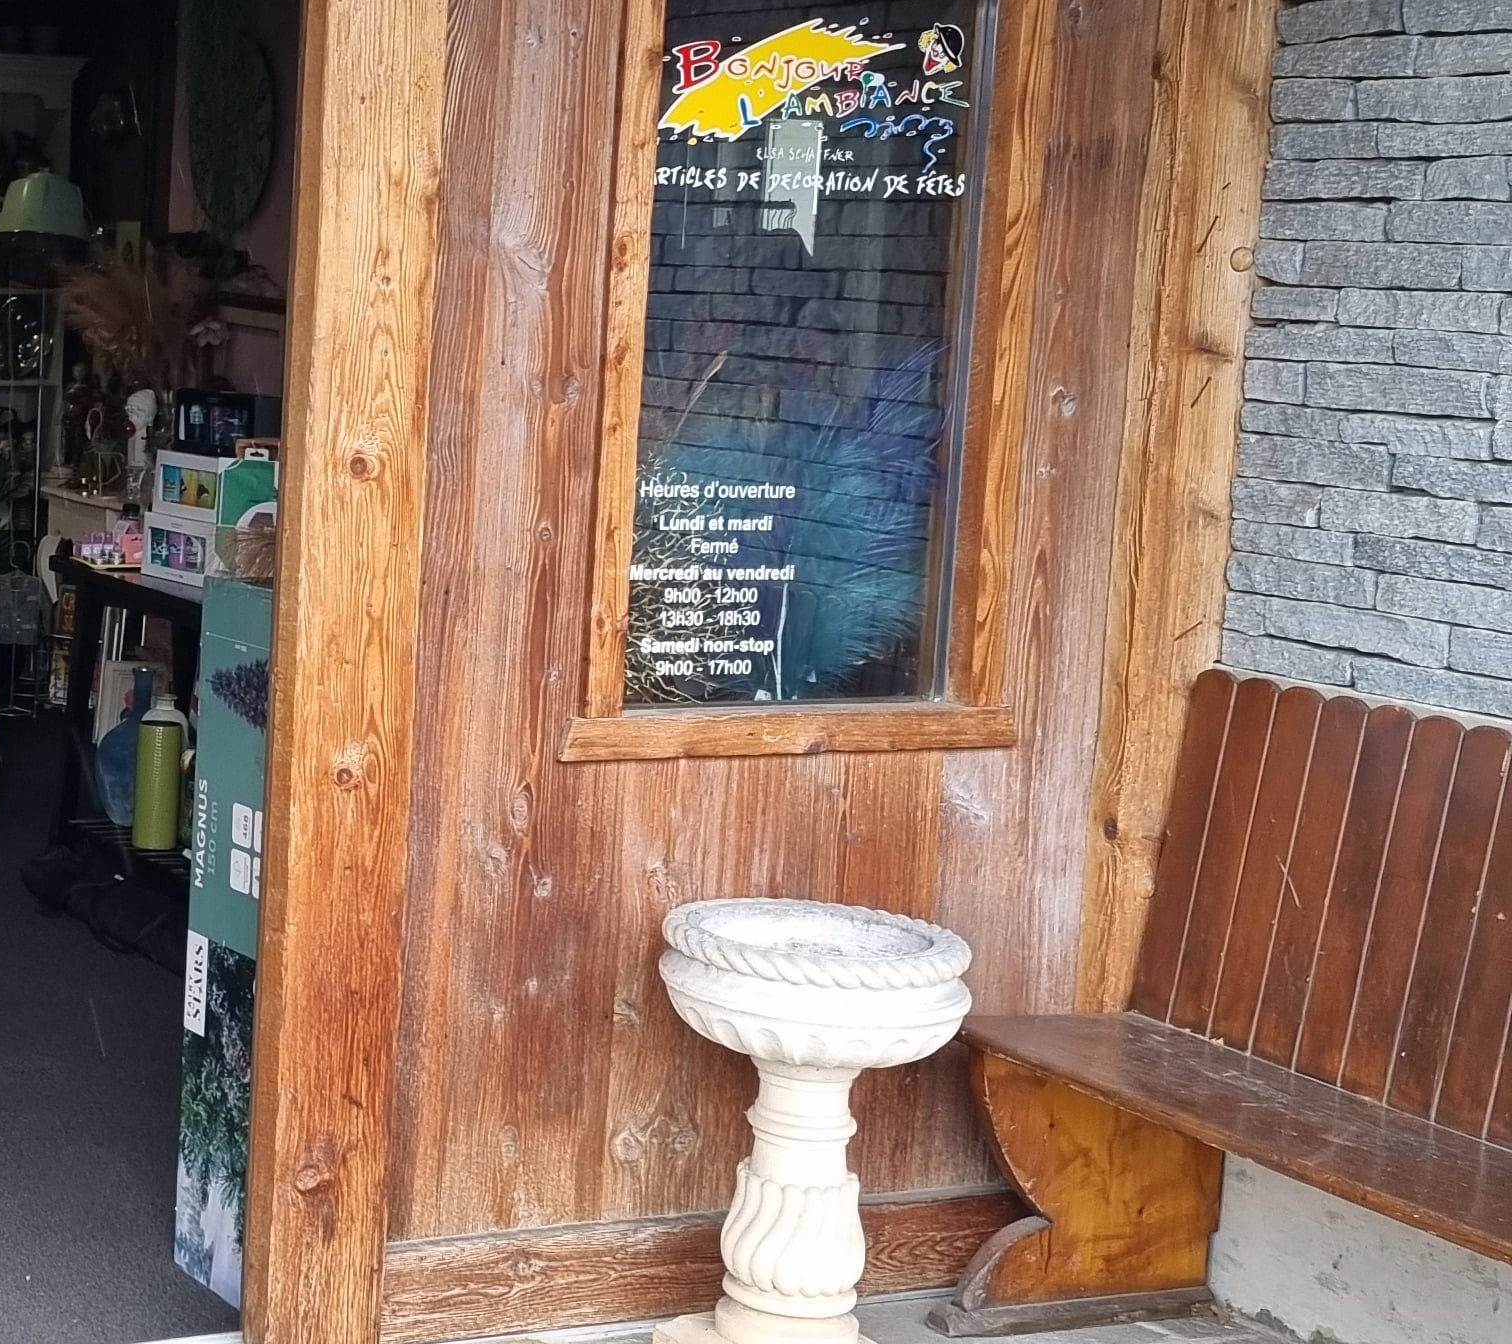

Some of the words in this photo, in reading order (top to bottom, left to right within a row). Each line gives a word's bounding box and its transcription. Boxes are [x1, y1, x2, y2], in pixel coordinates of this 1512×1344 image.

[788, 146, 855, 163] SCHAFNER
[736, 171, 761, 192] DE
[883, 174, 910, 199] DE
[639, 481, 699, 499] Heures
[704, 481, 796, 500] d'ouverture
[659, 515, 705, 532] Lundi
[708, 517, 724, 531] et
[728, 515, 773, 532] mardi
[691, 537, 739, 554] Fermé
[629, 565, 699, 581] Mercredi
[703, 568, 723, 581] au
[727, 564, 795, 581] vendredi
[663, 588, 701, 604] 9h00
[715, 587, 758, 604] 12h00
[659, 611, 704, 627] 13h30
[718, 610, 761, 627] 18h30
[639, 637, 700, 654] Samedi
[703, 637, 775, 656] non-stop
[655, 660, 694, 676] 9h00
[708, 659, 752, 676] 17h00
[210, 801, 219, 834] cm
[194, 778, 208, 888] MAGNUS
